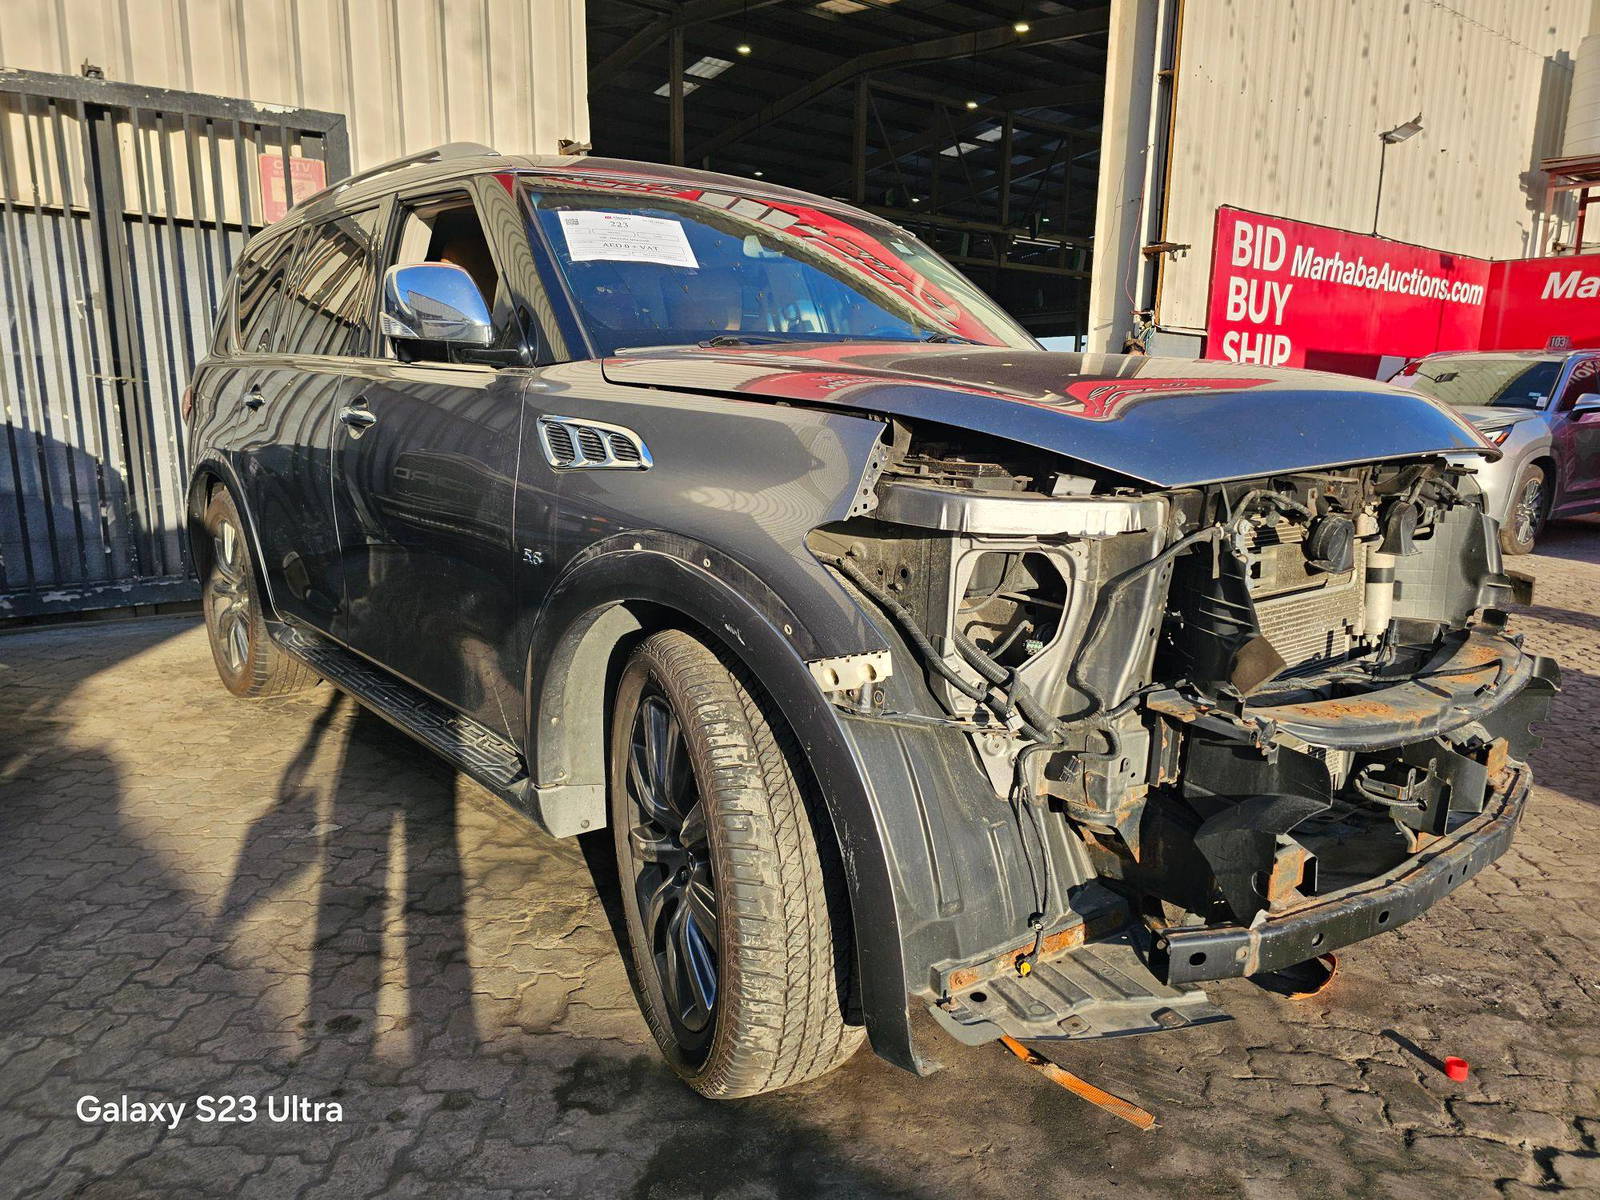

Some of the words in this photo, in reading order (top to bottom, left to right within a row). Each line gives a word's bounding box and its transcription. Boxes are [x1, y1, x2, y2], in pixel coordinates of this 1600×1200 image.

[273, 160, 311, 173] CTV
[1231, 219, 1287, 272] BID
[1226, 275, 1294, 326] BUY
[1290, 244, 1485, 306] MarhabaAuctions.com
[1222, 330, 1292, 367] SHIP
